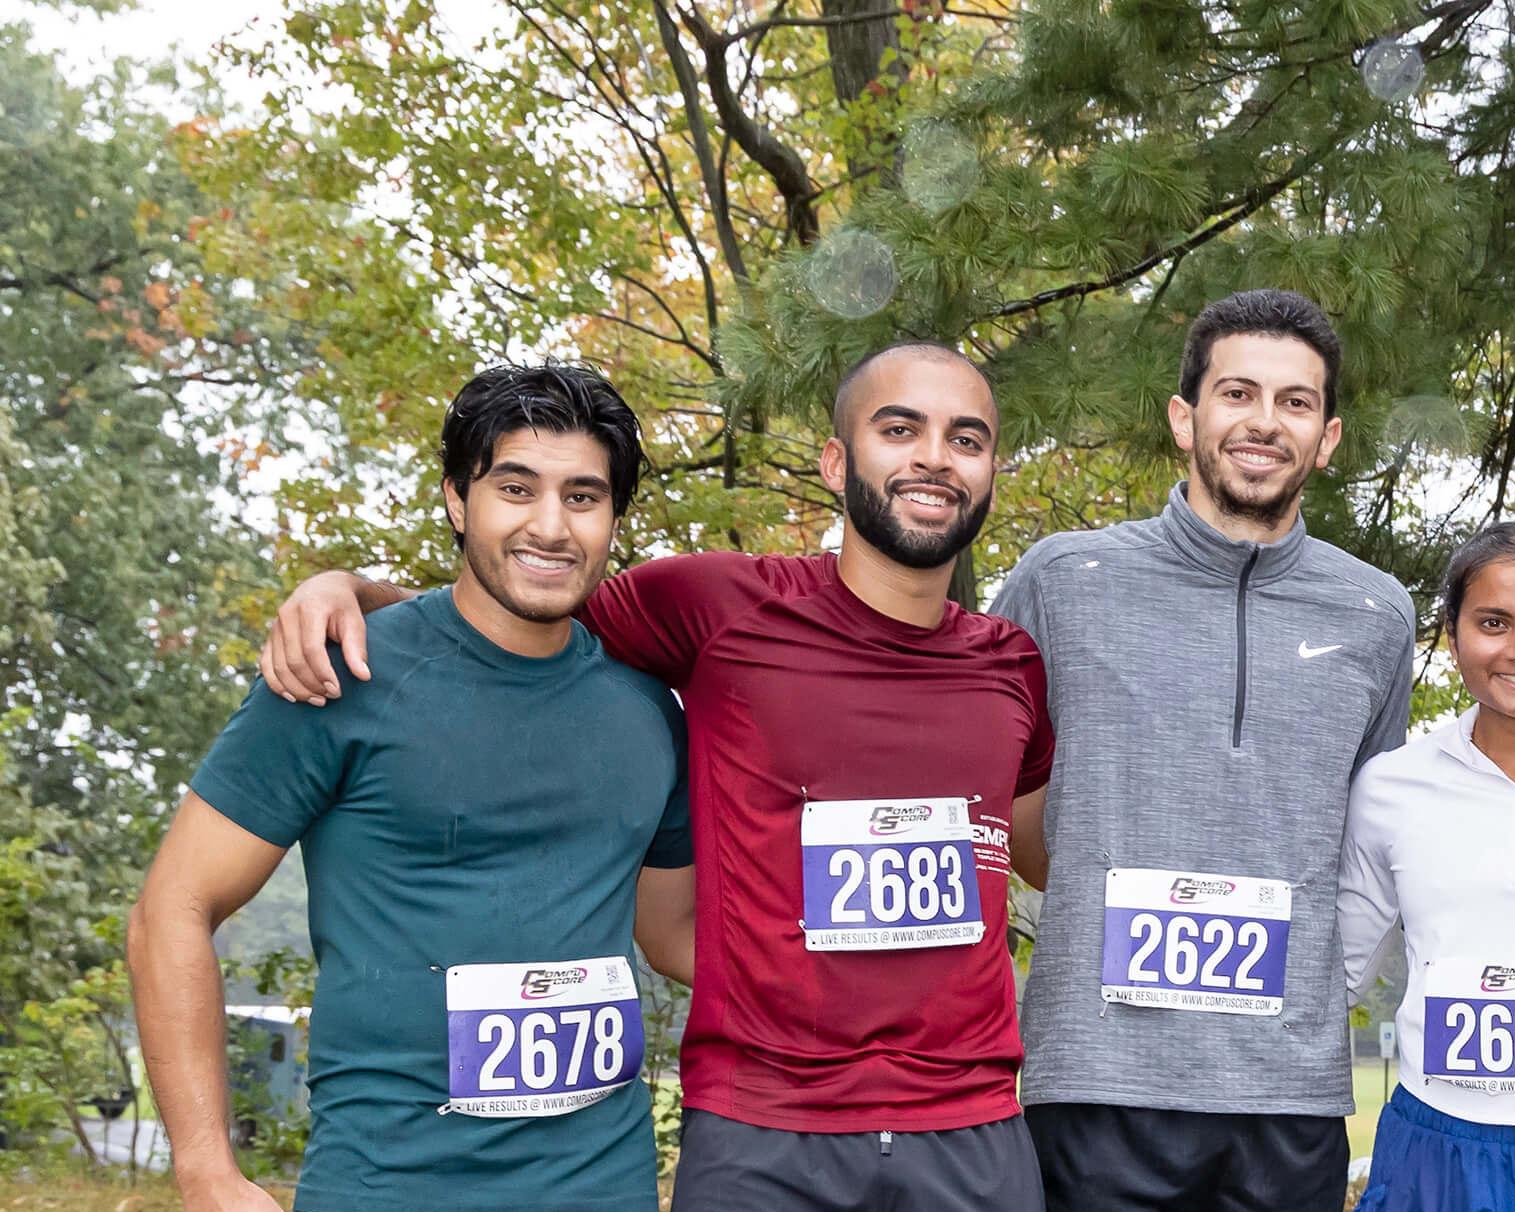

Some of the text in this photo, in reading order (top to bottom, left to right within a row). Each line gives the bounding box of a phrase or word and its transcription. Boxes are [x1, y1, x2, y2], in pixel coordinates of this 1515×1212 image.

[828, 844, 965, 923] 2683
[820, 933, 839, 945] LIVE
[841, 932, 878, 944] RESULTS
[880, 931, 890, 943] @
[1127, 912, 1269, 991] 2622
[1135, 991, 1169, 1003] RESULTS
[478, 1006, 624, 1091] 2678
[1454, 1080, 1487, 1091] RESULTS
[1488, 1080, 1498, 1092] @
[467, 1101, 486, 1113] LIVE
[489, 1100, 528, 1112] RESULTS
[530, 1099, 542, 1111] @
